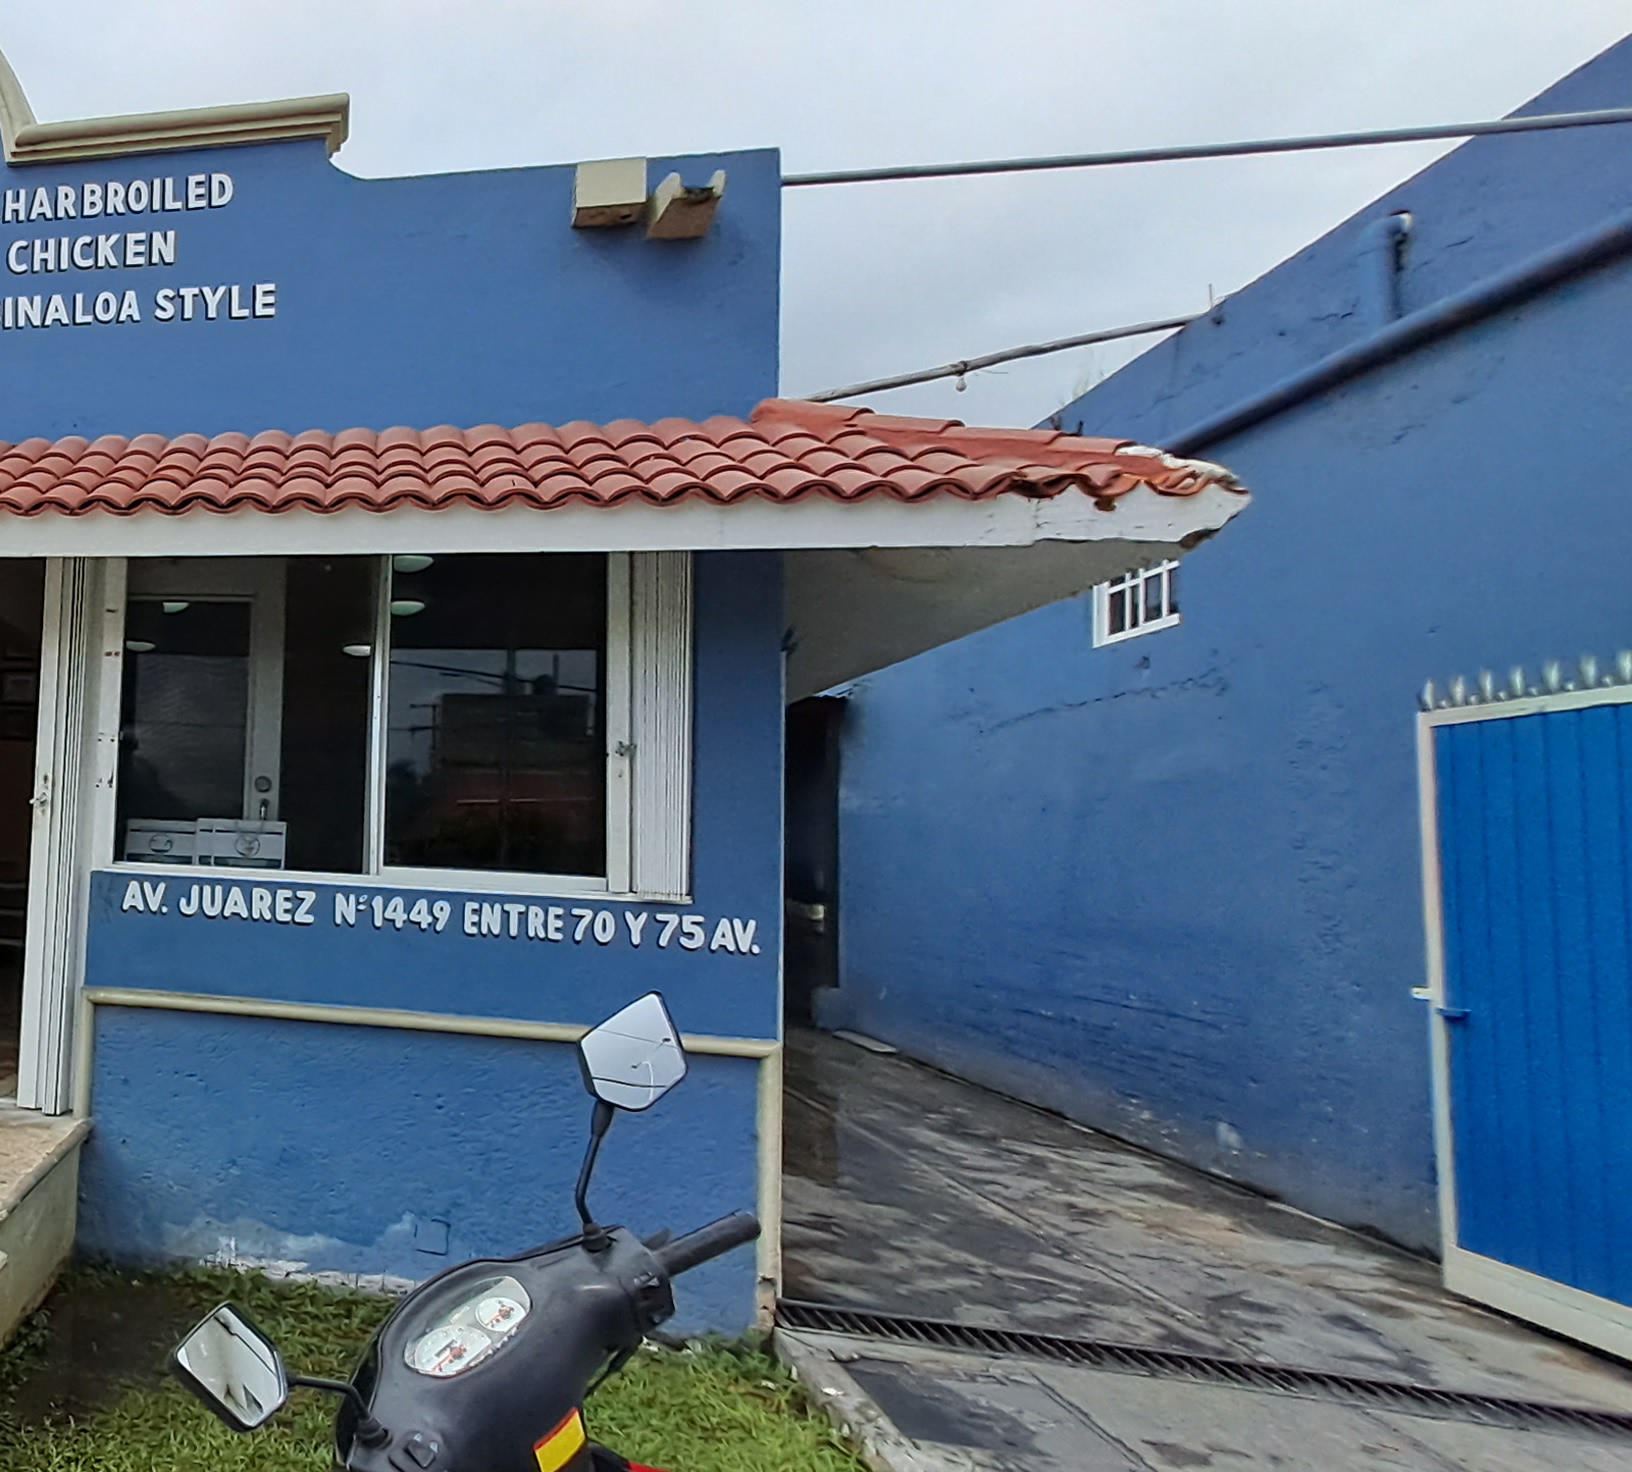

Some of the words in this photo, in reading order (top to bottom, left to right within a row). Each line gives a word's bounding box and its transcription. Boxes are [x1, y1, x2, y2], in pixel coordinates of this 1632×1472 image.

[7, 230, 176, 274] CHICKEN
[154, 282, 277, 321] STYLE
[121, 880, 169, 914] AV.
[179, 884, 316, 925] JUAREZ
[371, 895, 452, 934] 1449
[463, 901, 564, 942] ENTRE
[570, 907, 615, 946] 70
[624, 911, 648, 948] Y
[654, 913, 706, 950] 75
[709, 917, 761, 955] AV.
